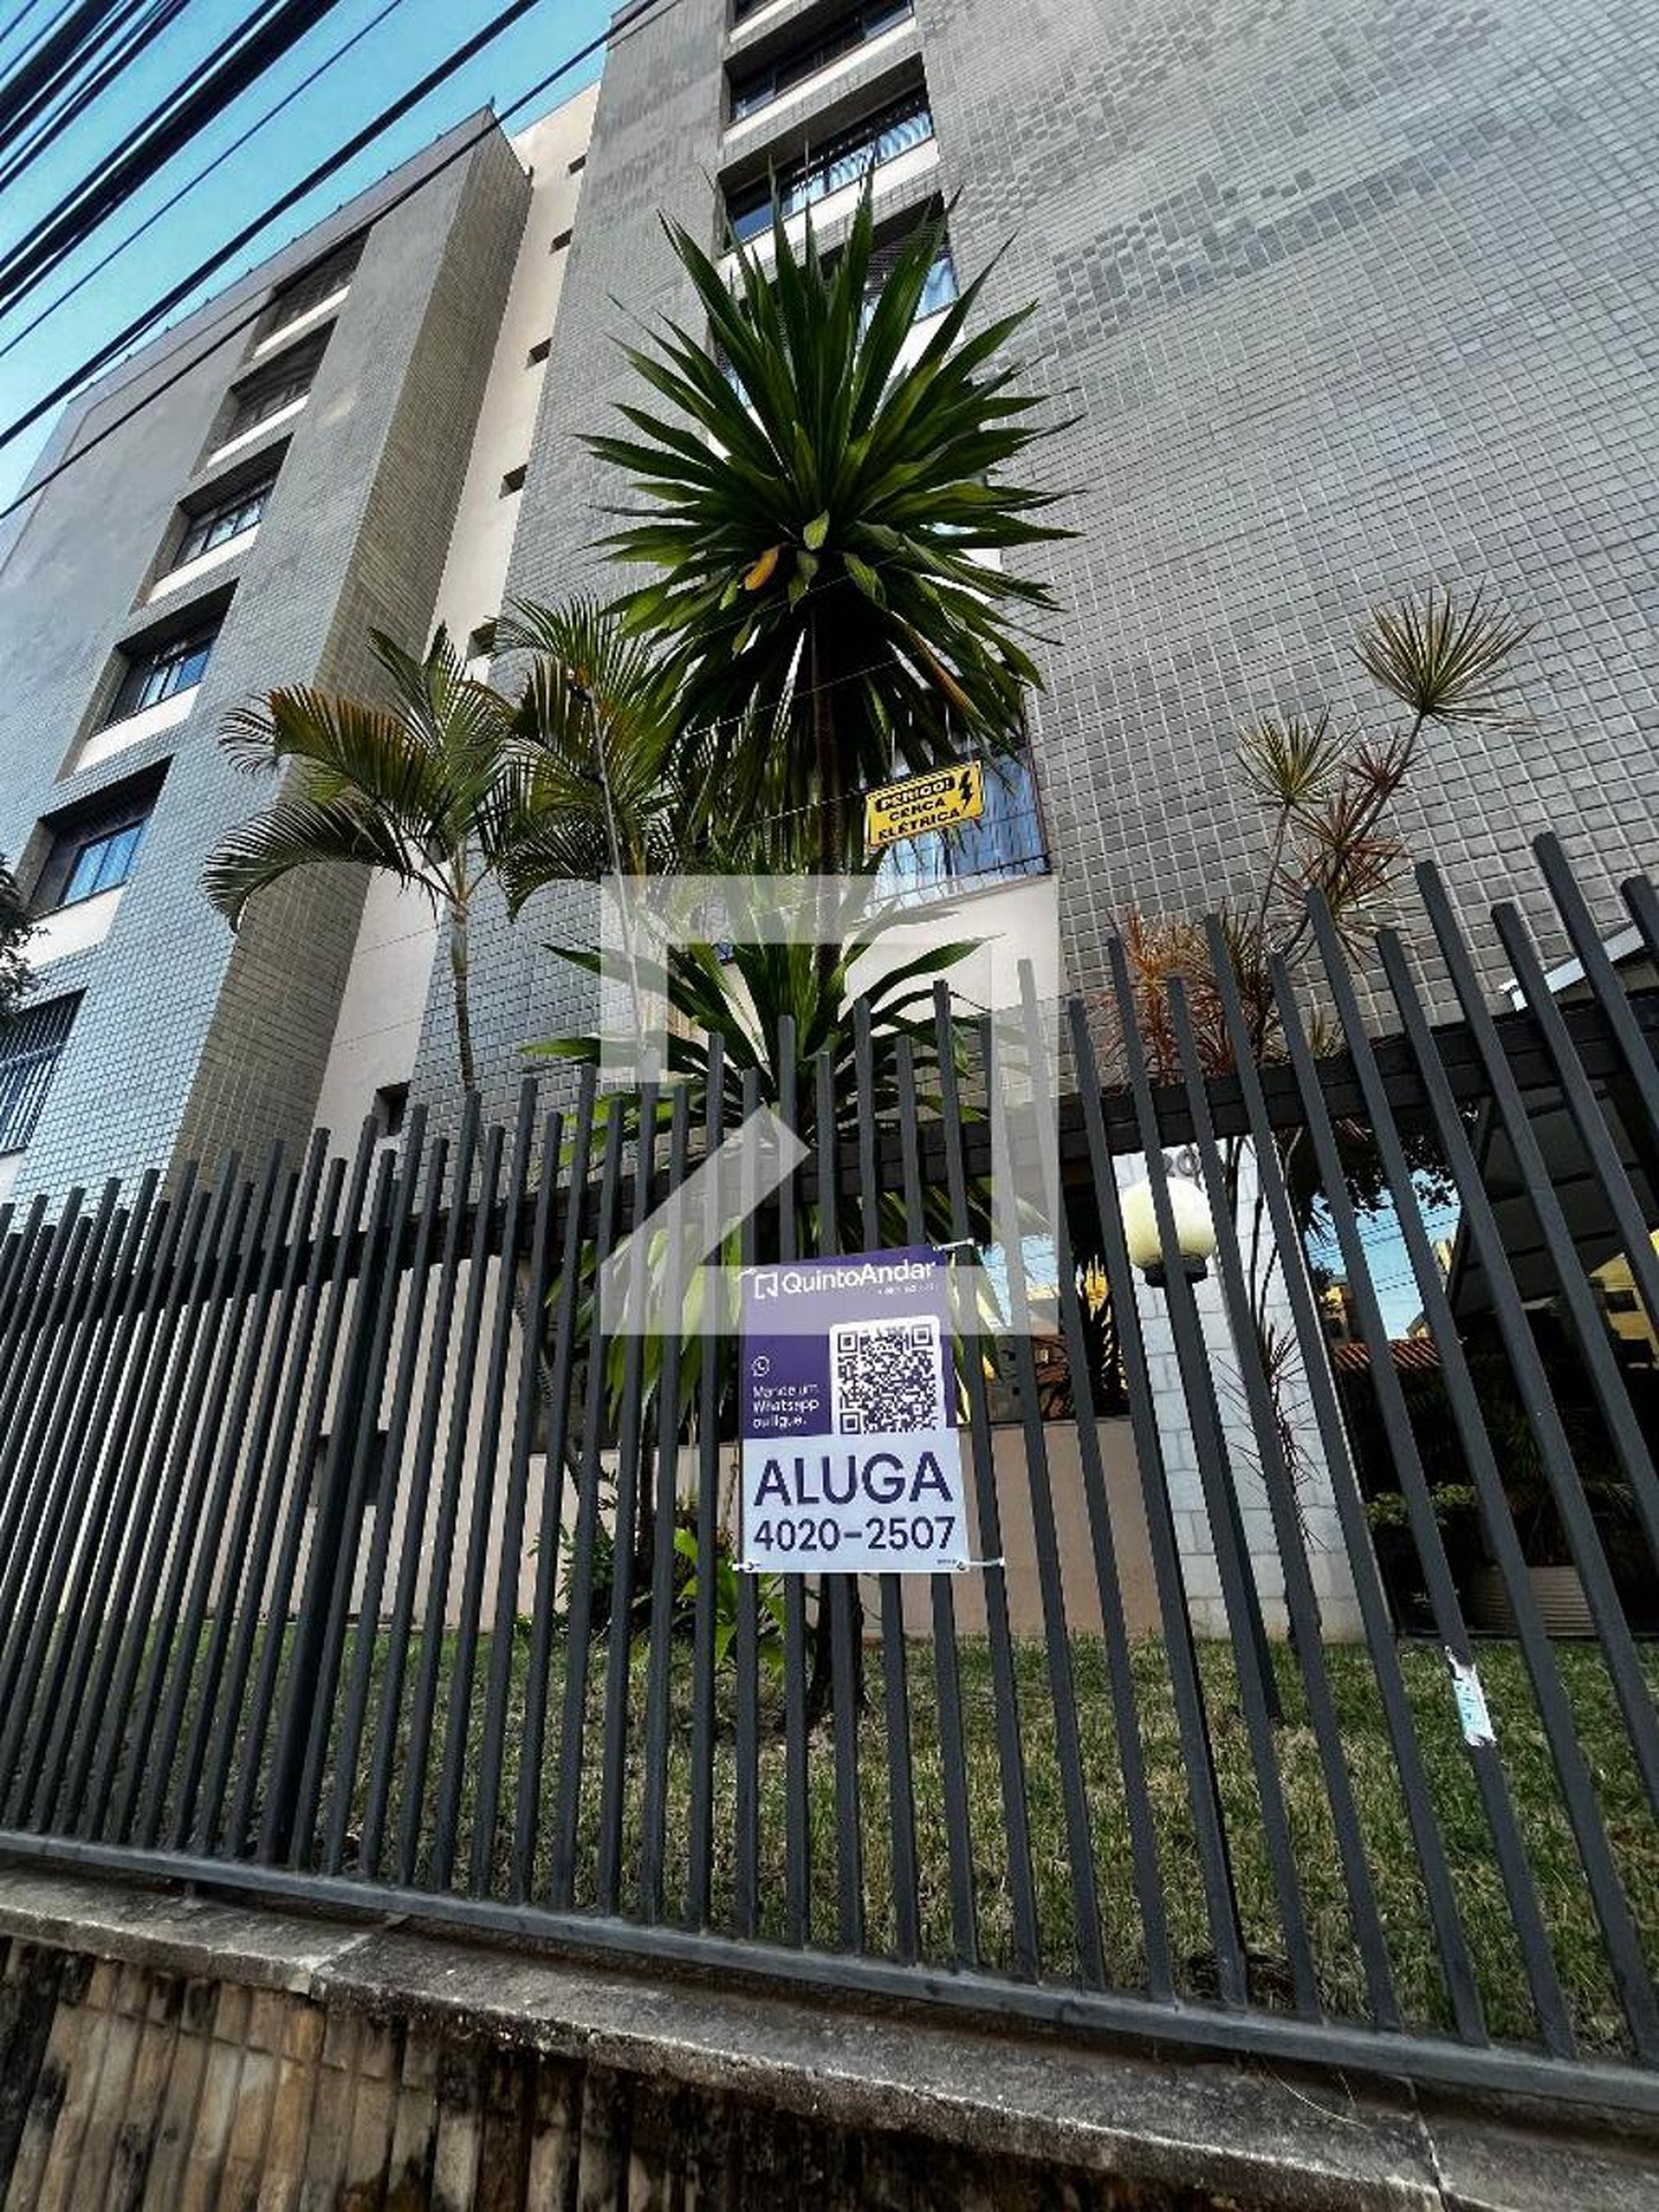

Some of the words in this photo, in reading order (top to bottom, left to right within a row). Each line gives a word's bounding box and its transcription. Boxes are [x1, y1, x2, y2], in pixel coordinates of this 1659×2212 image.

[782, 1259, 936, 1293] QuintoAndar
[753, 1451, 953, 1506] ALUGA
[753, 1515, 956, 1551] 4020-2507
